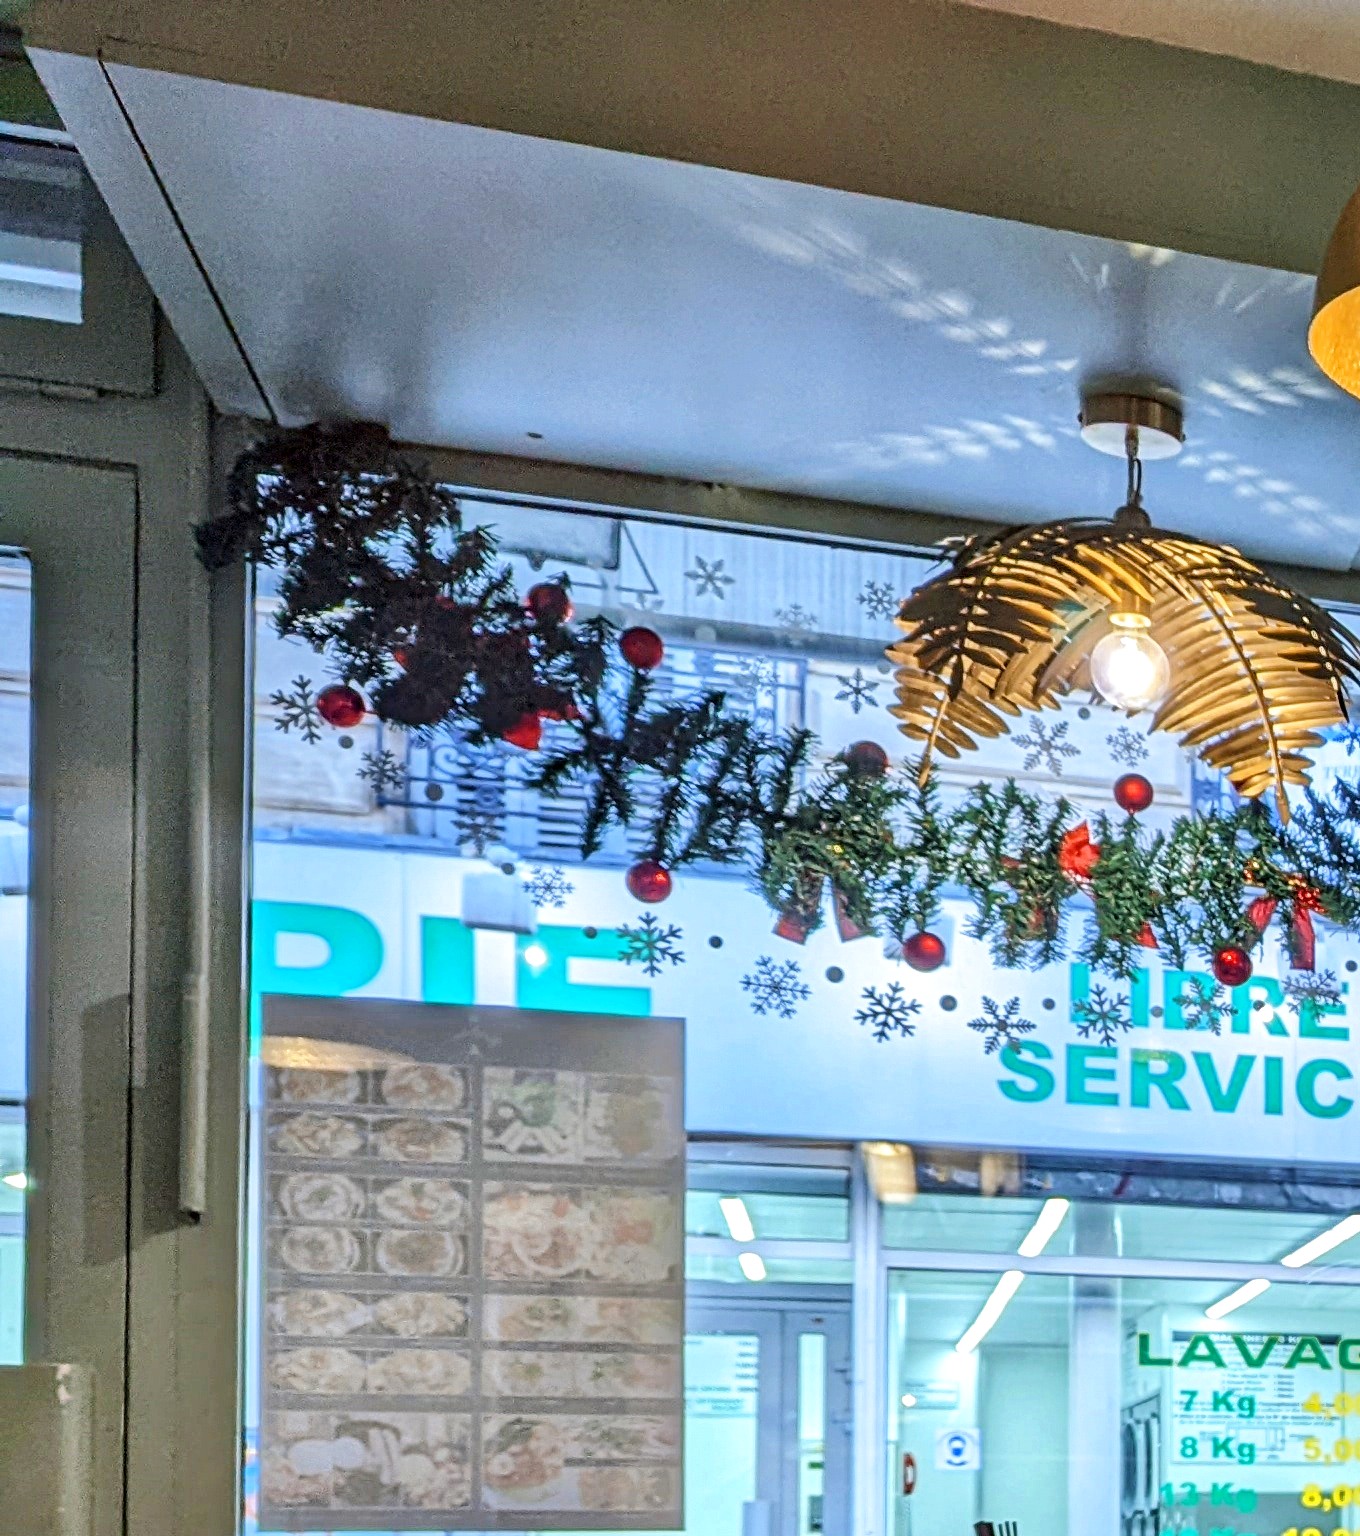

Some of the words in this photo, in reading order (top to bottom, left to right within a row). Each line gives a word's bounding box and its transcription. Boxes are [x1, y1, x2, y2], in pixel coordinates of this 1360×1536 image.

[1180, 1390, 1198, 1412] 7
[1212, 1390, 1256, 1419] Kg
[1180, 1436, 1198, 1459] 8
[1212, 1436, 1256, 1465] Kg
[1210, 1482, 1257, 1513] Kg
